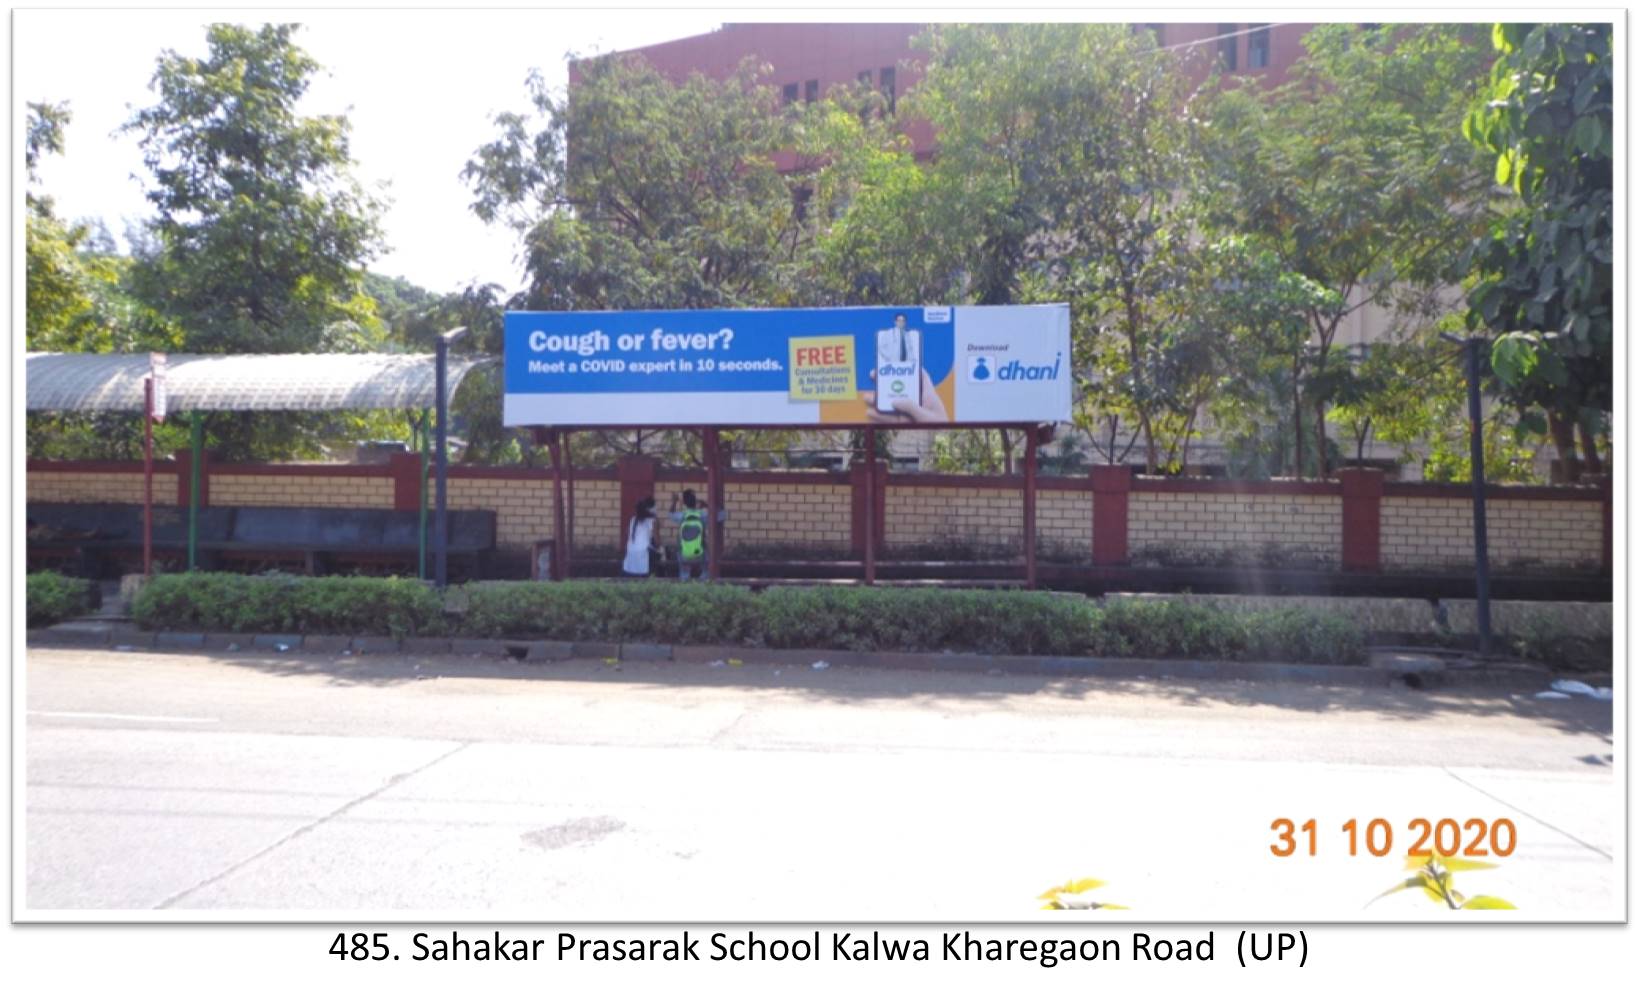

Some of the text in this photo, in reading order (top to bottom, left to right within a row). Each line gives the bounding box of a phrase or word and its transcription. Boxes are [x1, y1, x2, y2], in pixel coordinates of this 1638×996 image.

[529, 328, 734, 356] Cough or fever?
[967, 344, 1009, 352] Download
[796, 345, 847, 367] FREE
[529, 359, 783, 374] Meet a COVID expert in 10 seconds.
[795, 366, 851, 377] Consultations
[880, 363, 917, 377] dhani
[997, 352, 1062, 381] dhani
[806, 376, 849, 385] Medicines
[802, 386, 814, 395] for
[827, 385, 846, 394] days
